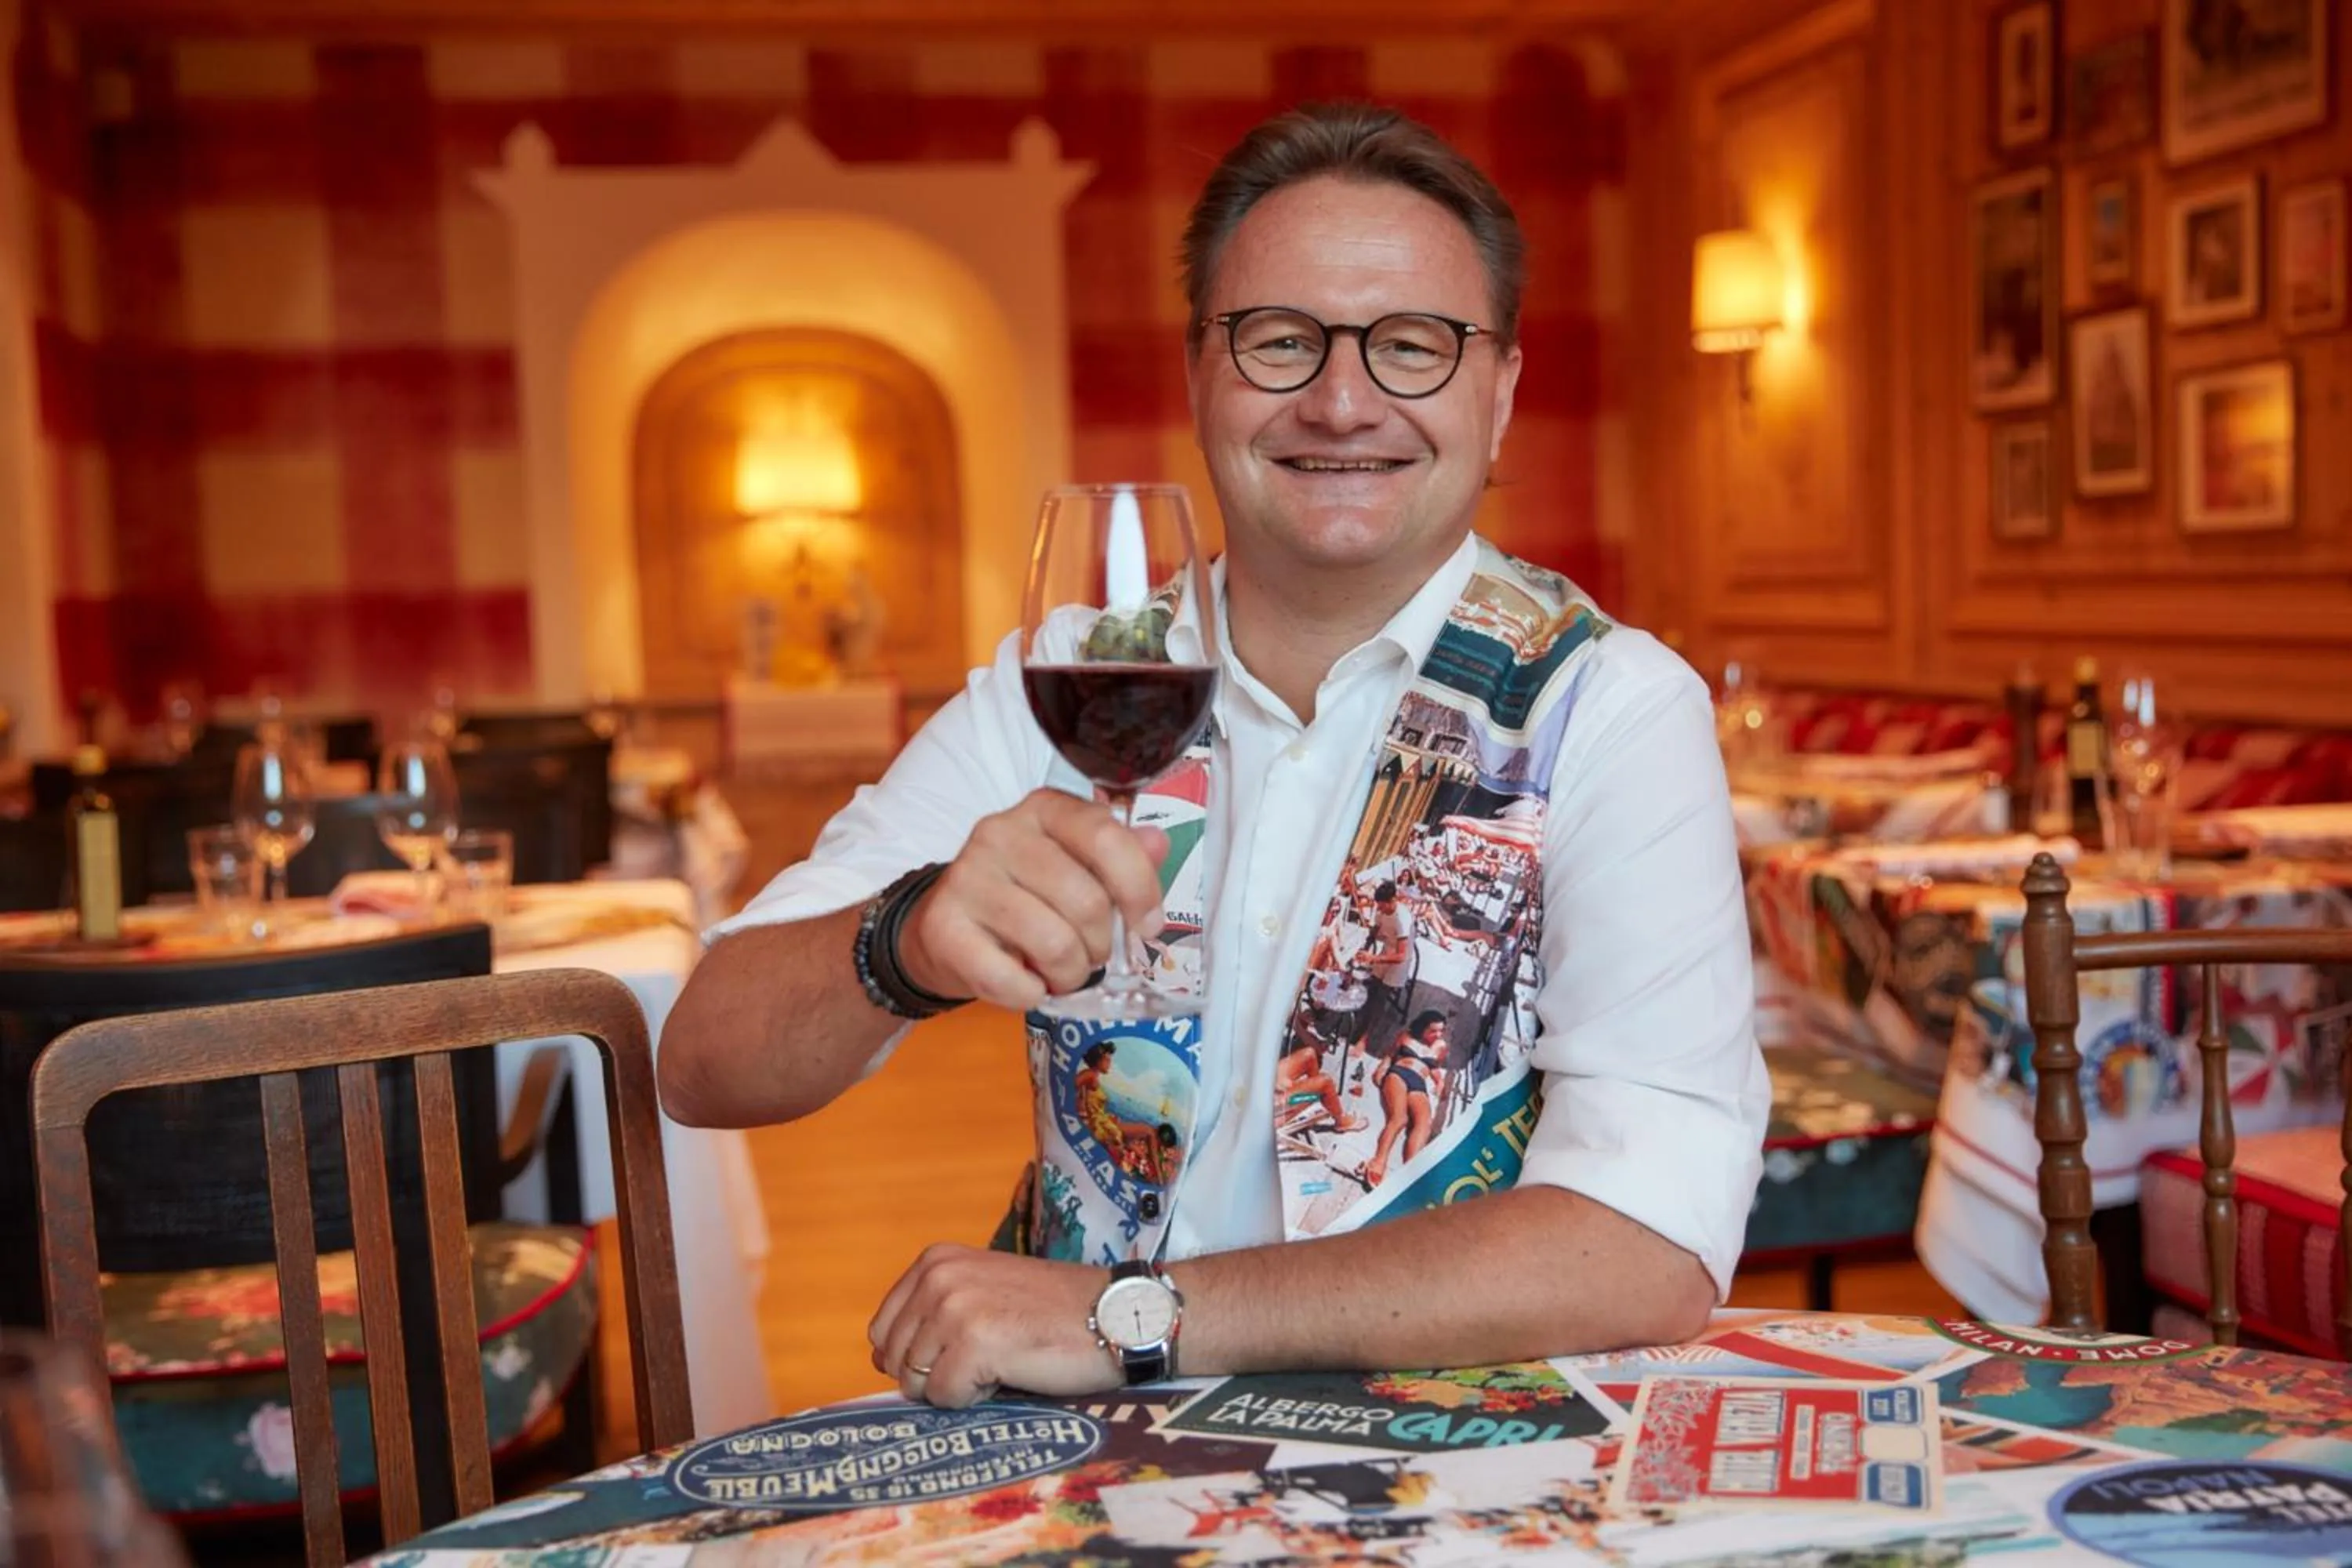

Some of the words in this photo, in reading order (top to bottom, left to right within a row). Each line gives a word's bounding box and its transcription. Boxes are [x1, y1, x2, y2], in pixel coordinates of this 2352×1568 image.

[1944, 1321, 2043, 1357] MILAN
[1207, 1407, 1247, 1426] LA
[1250, 1412, 1372, 1436] PALMA
[1225, 1392, 1396, 1421] ALBERGO
[1386, 1412, 1565, 1447] CAPRI
